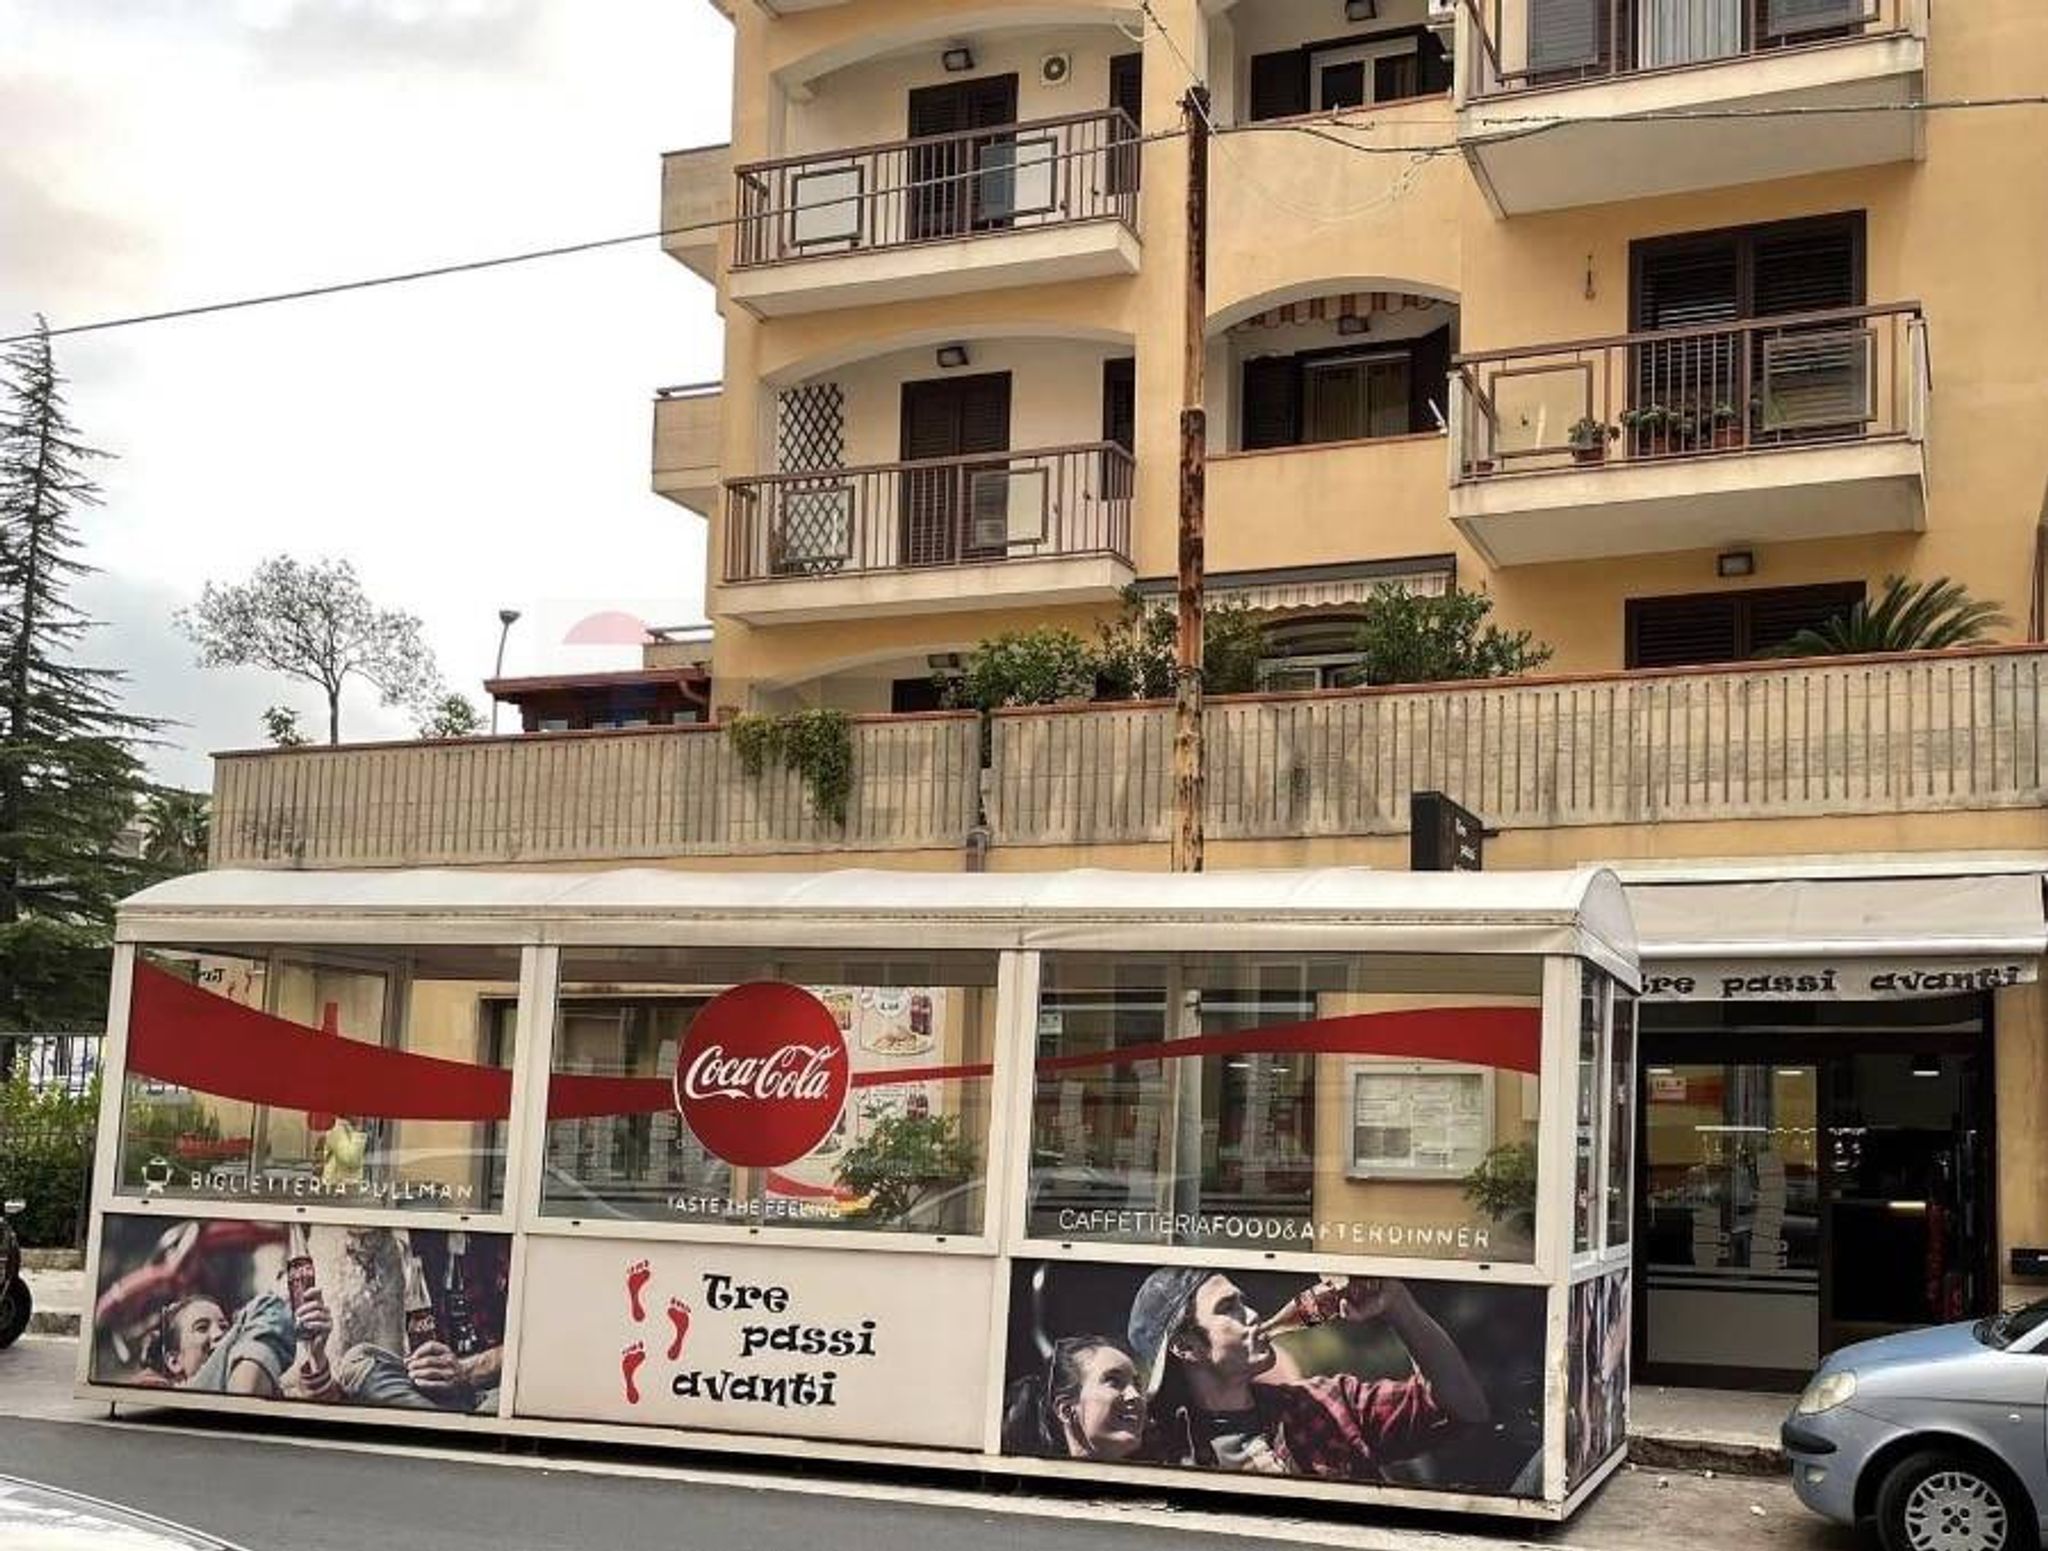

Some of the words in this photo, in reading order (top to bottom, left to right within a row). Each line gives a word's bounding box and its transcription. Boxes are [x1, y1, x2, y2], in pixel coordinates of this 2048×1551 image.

[1721, 969, 1838, 997] passi
[1870, 965, 2020, 992] avanti
[685, 1045, 840, 1099] Coca-Cola
[359, 1181, 474, 1201] PULLMAN
[668, 1197, 719, 1214] TASTE
[725, 1199, 760, 1216] THE
[764, 1200, 840, 1218] FEELING
[703, 1273, 789, 1313] Tre
[740, 1320, 876, 1357] passi
[672, 1370, 837, 1407] avanti
